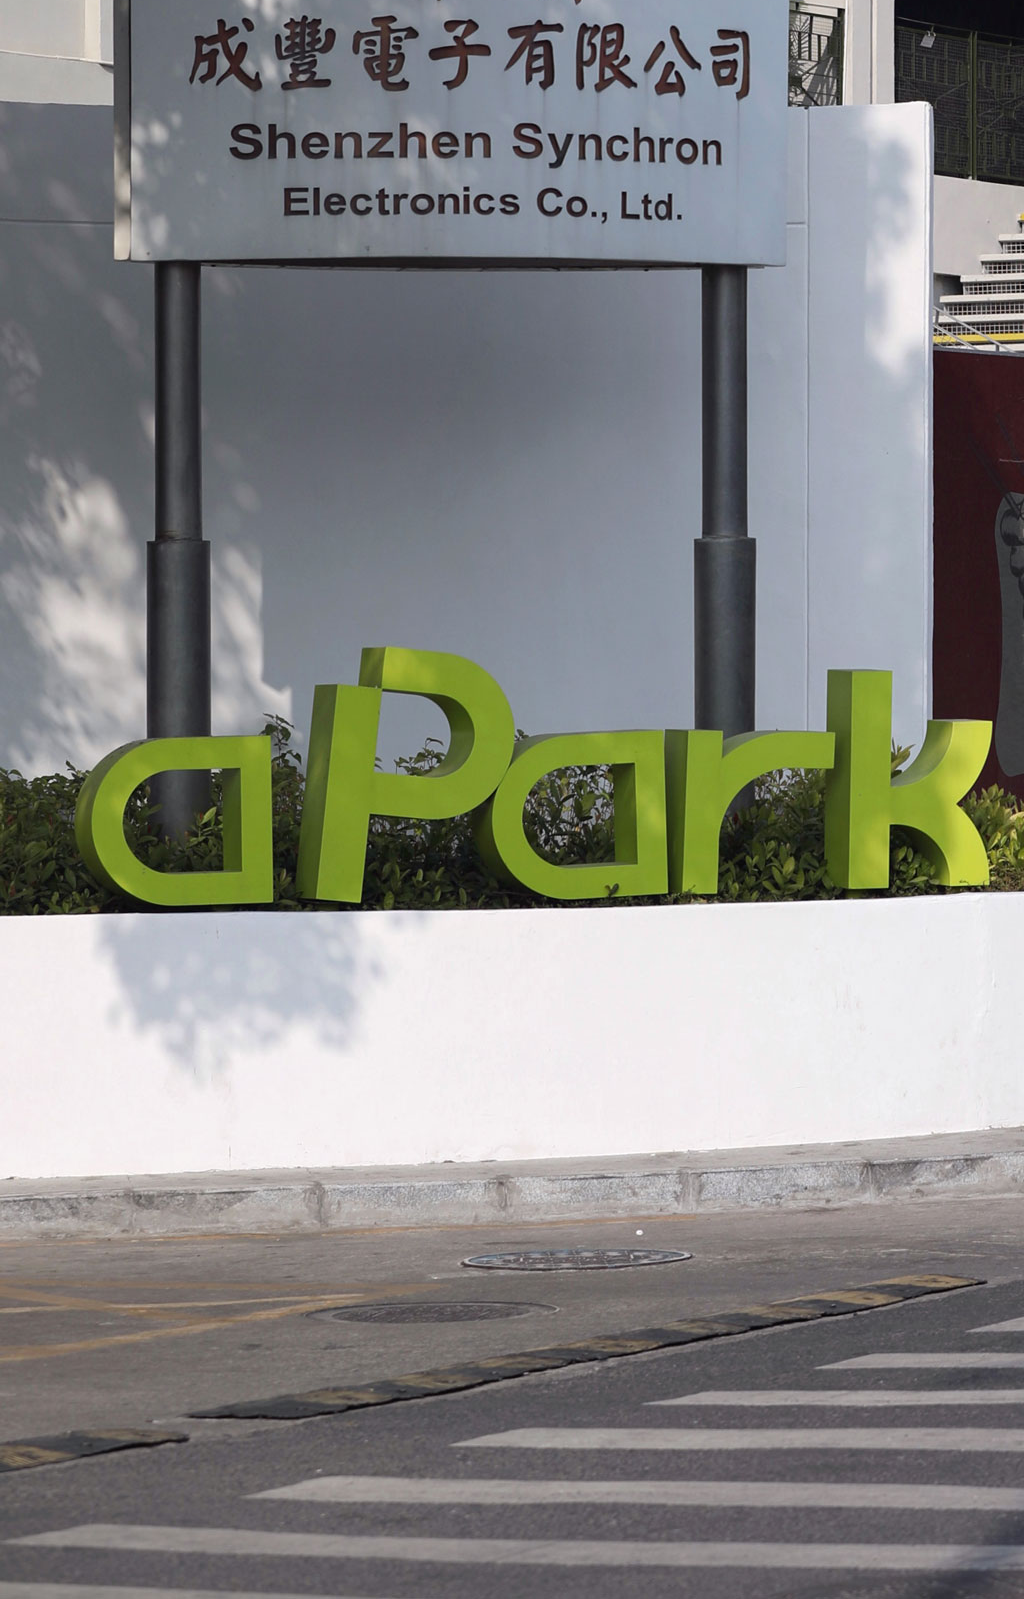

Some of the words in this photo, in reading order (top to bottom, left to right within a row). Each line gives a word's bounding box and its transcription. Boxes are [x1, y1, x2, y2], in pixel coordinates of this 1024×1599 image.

[229, 122, 492, 161] Shenzhen
[511, 123, 724, 169] Synchron
[282, 186, 521, 217] Electronics
[536, 189, 608, 223] Co.,
[620, 192, 683, 222] Ltd.
[75, 645, 993, 906] aPark
